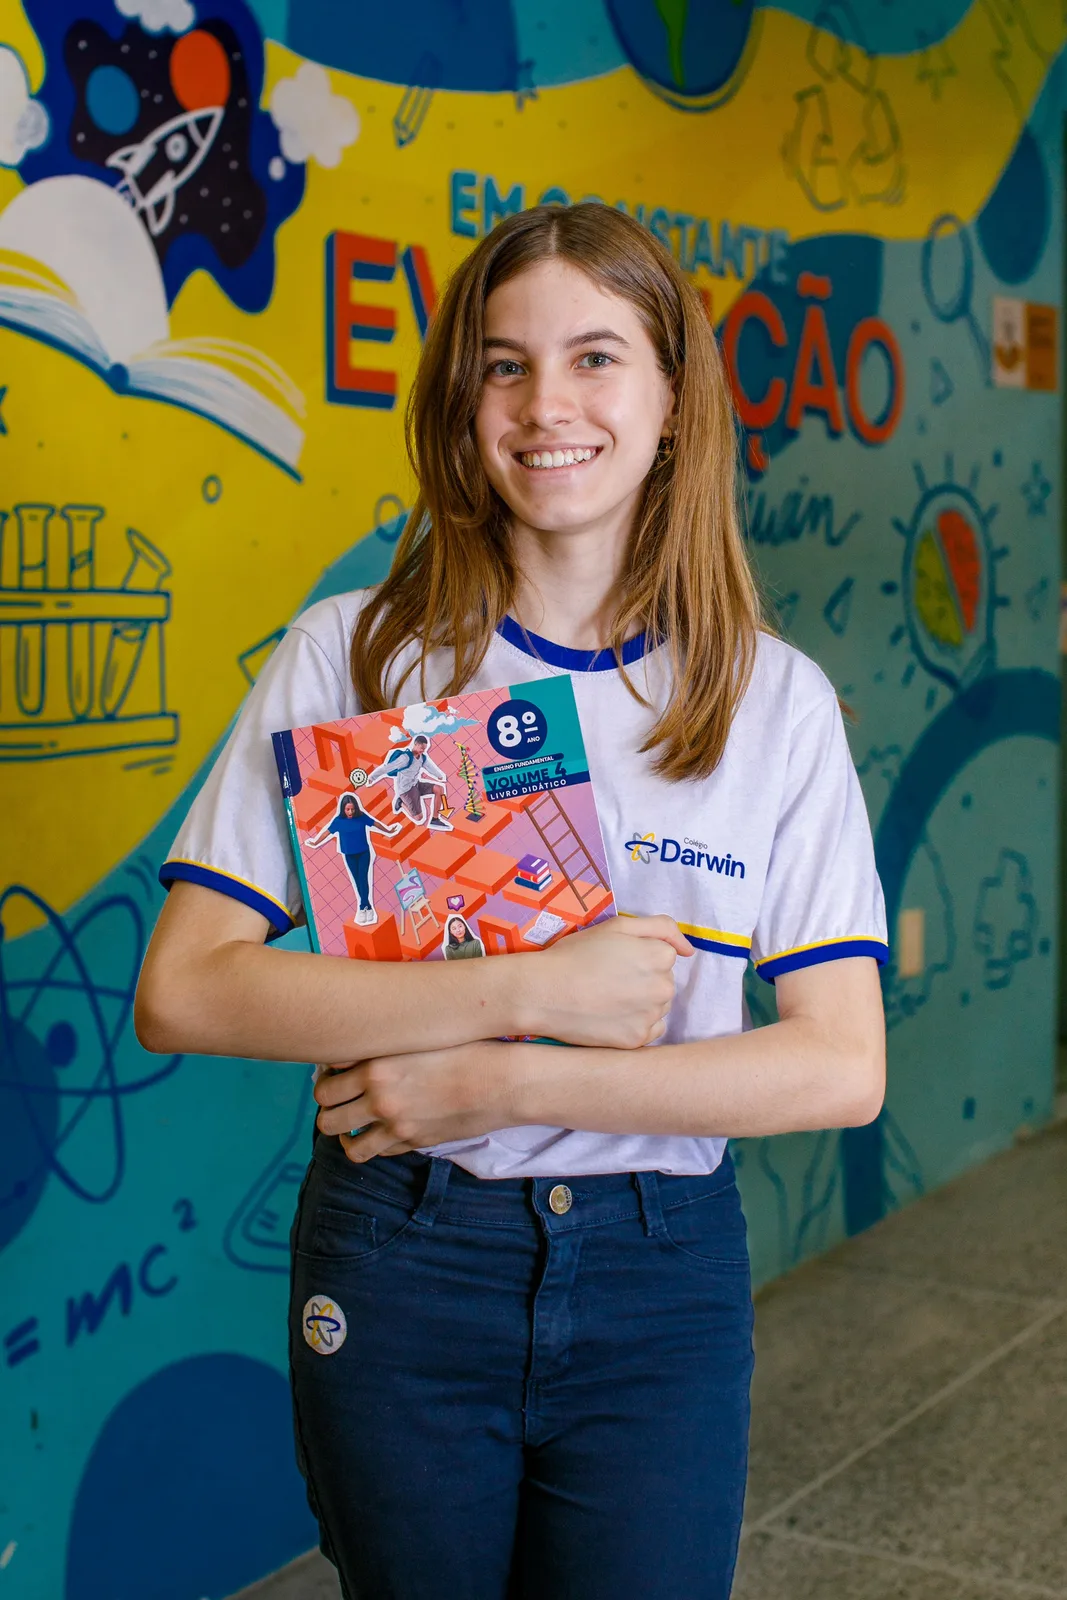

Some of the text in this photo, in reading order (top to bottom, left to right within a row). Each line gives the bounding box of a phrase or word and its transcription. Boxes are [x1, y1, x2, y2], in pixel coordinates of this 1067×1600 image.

[448, 168, 526, 239] EM
[487, 762, 567, 790] VOLUME 4
[494, 756, 554, 772] ENSINO FUNDAMENTAL
[490, 779, 567, 800] LIVRO DIDÁTICO
[684, 837, 708, 849] Colégio
[660, 838, 745, 879] Darwin
